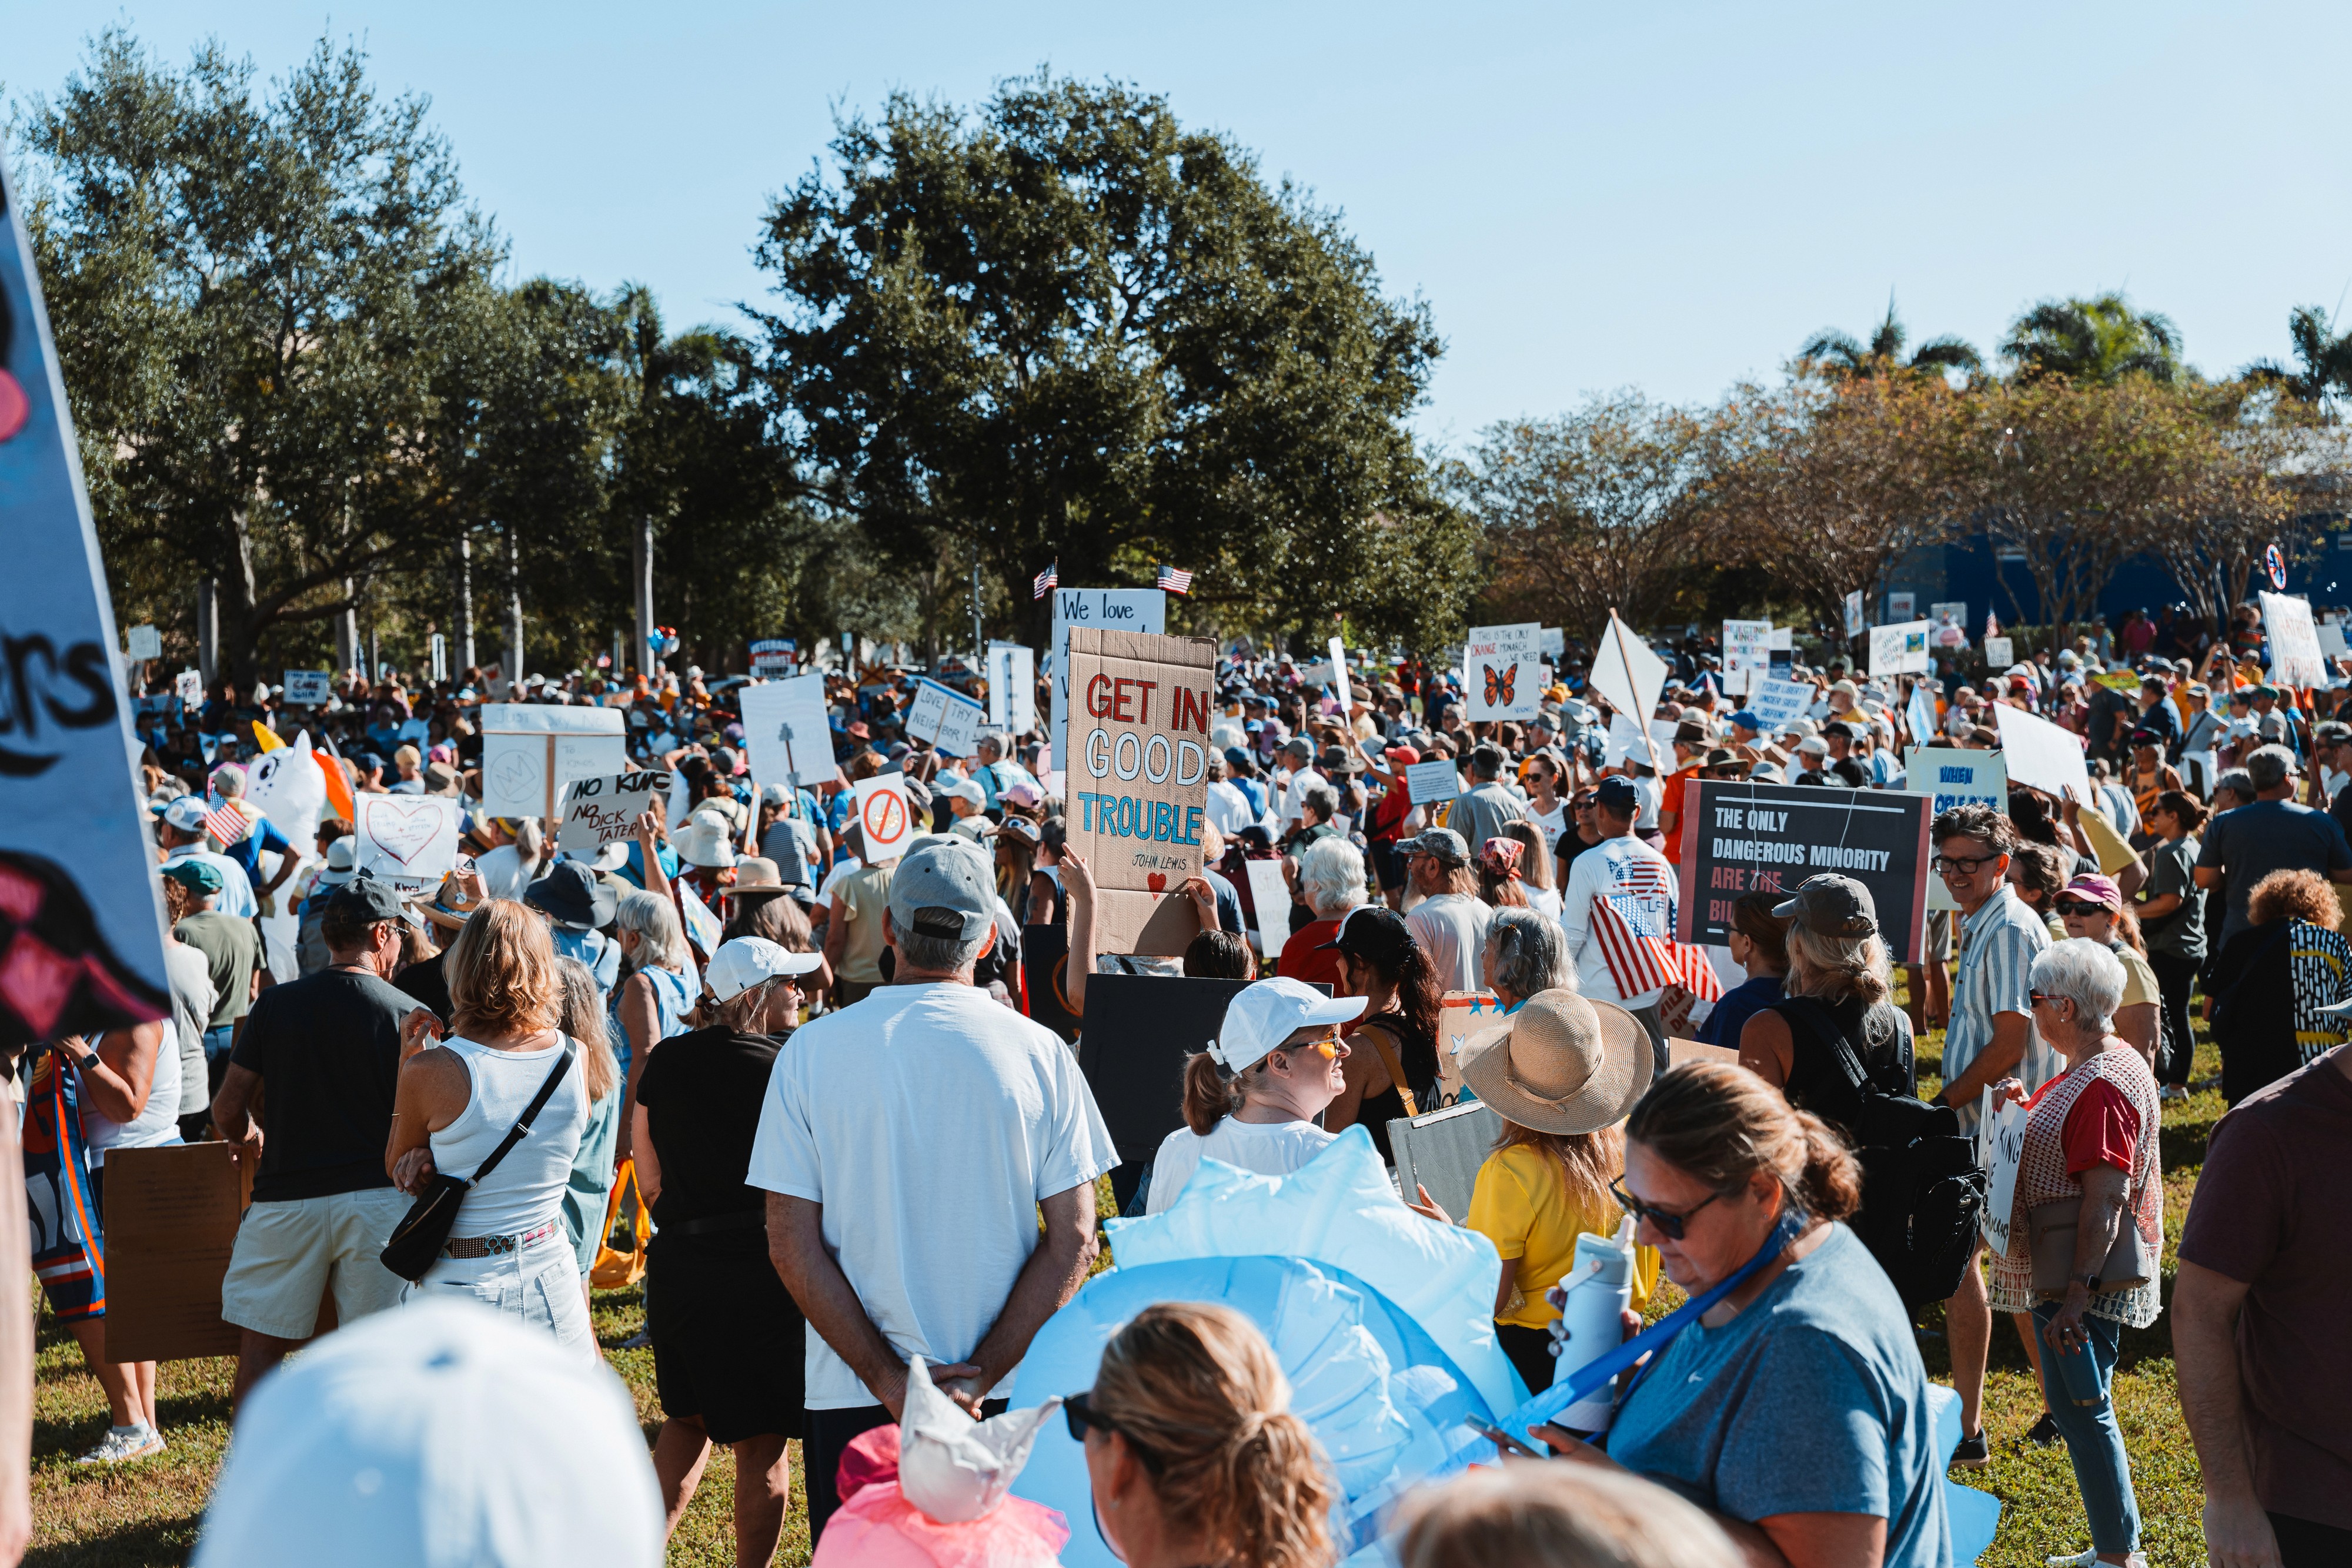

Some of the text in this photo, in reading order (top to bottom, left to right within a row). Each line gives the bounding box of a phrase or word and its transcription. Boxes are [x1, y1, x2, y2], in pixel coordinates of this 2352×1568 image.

[1063, 591, 1134, 620] We love
[1476, 631, 1490, 641] THIS
[1501, 629, 1512, 640] THE
[1515, 628, 1529, 640] ONLY
[1723, 624, 1767, 634] REJECTING
[1733, 633, 1759, 642] KINGS
[1471, 641, 1527, 657] ORANGE MONARCH
[1510, 651, 1538, 662] WE NEED
[1723, 646, 1748, 654] SINCE
[1781, 684, 1808, 696] LIBERTY
[920, 688, 973, 723] LOVE THY
[1087, 673, 1157, 725] GET
[1171, 686, 1208, 734] IN
[1085, 728, 1205, 786] GOOD
[1939, 765, 1973, 785] WHEN
[573, 771, 670, 800] NO KING
[572, 804, 599, 822] NO
[589, 808, 627, 829] DICK
[1078, 791, 1203, 846] TROUBLE
[1715, 807, 1789, 833] THE ONLY
[596, 823, 638, 843] TATER
[1132, 854, 1187, 871] JOHN LEWIS
[1712, 838, 1890, 872] DANGEROUS MINORITY
[1710, 867, 1783, 894] ARE THE
[1982, 1104, 2023, 1165] NO KING
